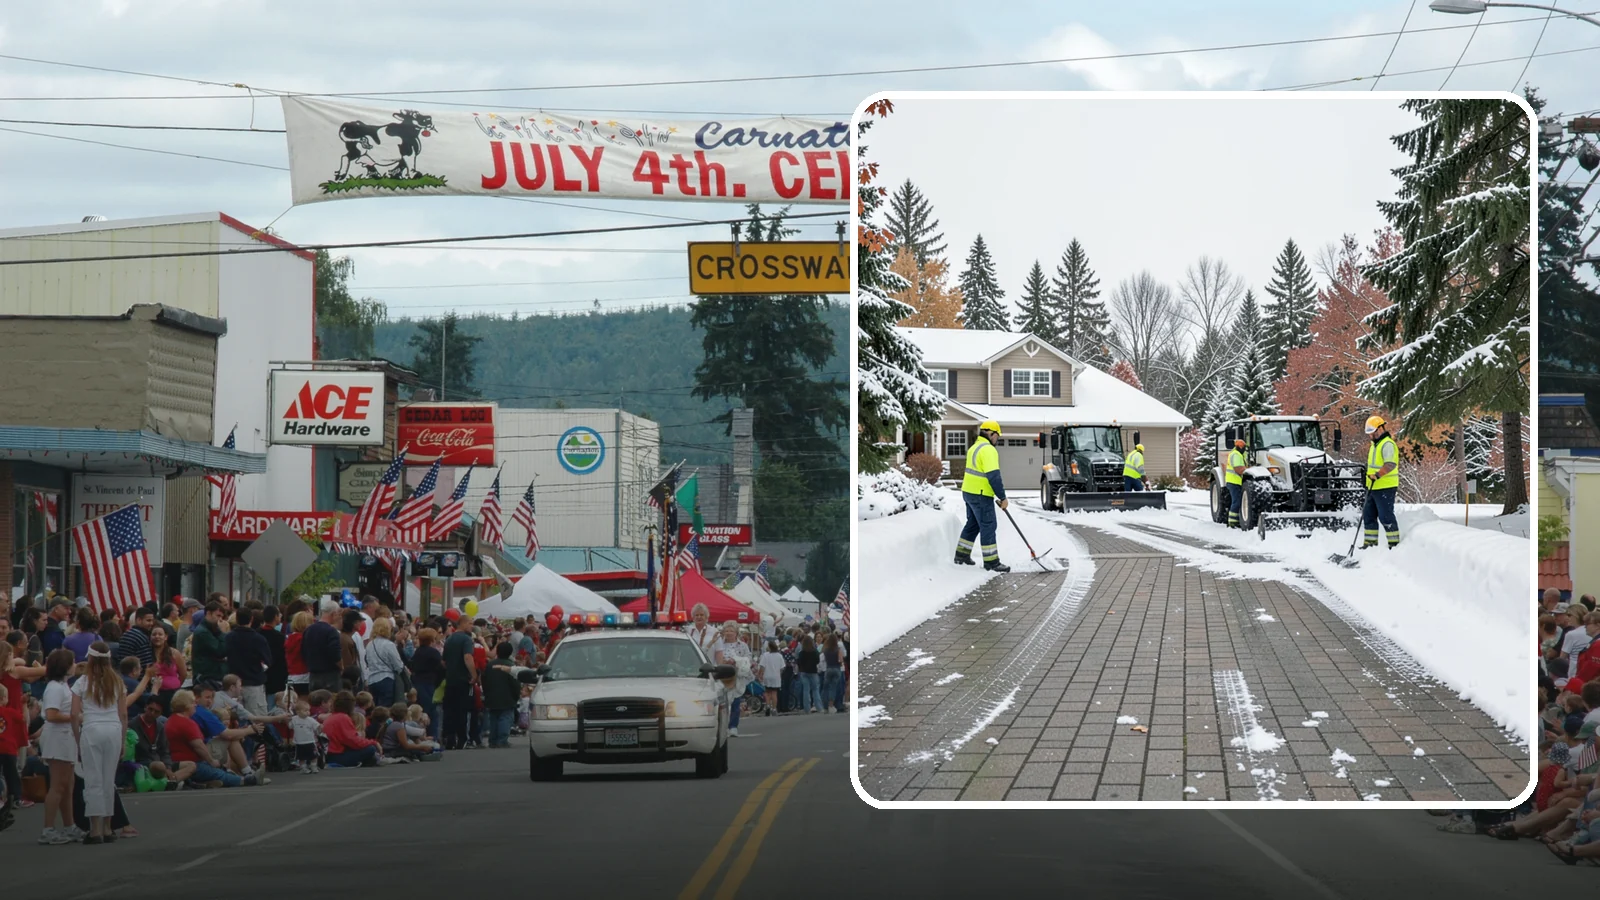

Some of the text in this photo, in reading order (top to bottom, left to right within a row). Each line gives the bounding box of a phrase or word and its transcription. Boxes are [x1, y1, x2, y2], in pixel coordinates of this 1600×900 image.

[481, 141, 605, 192] JULY
[632, 150, 746, 198] 4th.
[697, 254, 850, 280] CROSSWA
[283, 380, 373, 420] ACE
[405, 409, 485, 422] CEDAR LOG
[283, 421, 370, 436] Hardware
[353, 467, 386, 481] Simpl
[96, 485, 124, 494] Vincent
[126, 486, 135, 495] de
[137, 486, 155, 495] Paul
[212, 516, 331, 535] HARDARE
[688, 526, 741, 535] CRNATION
[699, 535, 730, 543] GLASS
